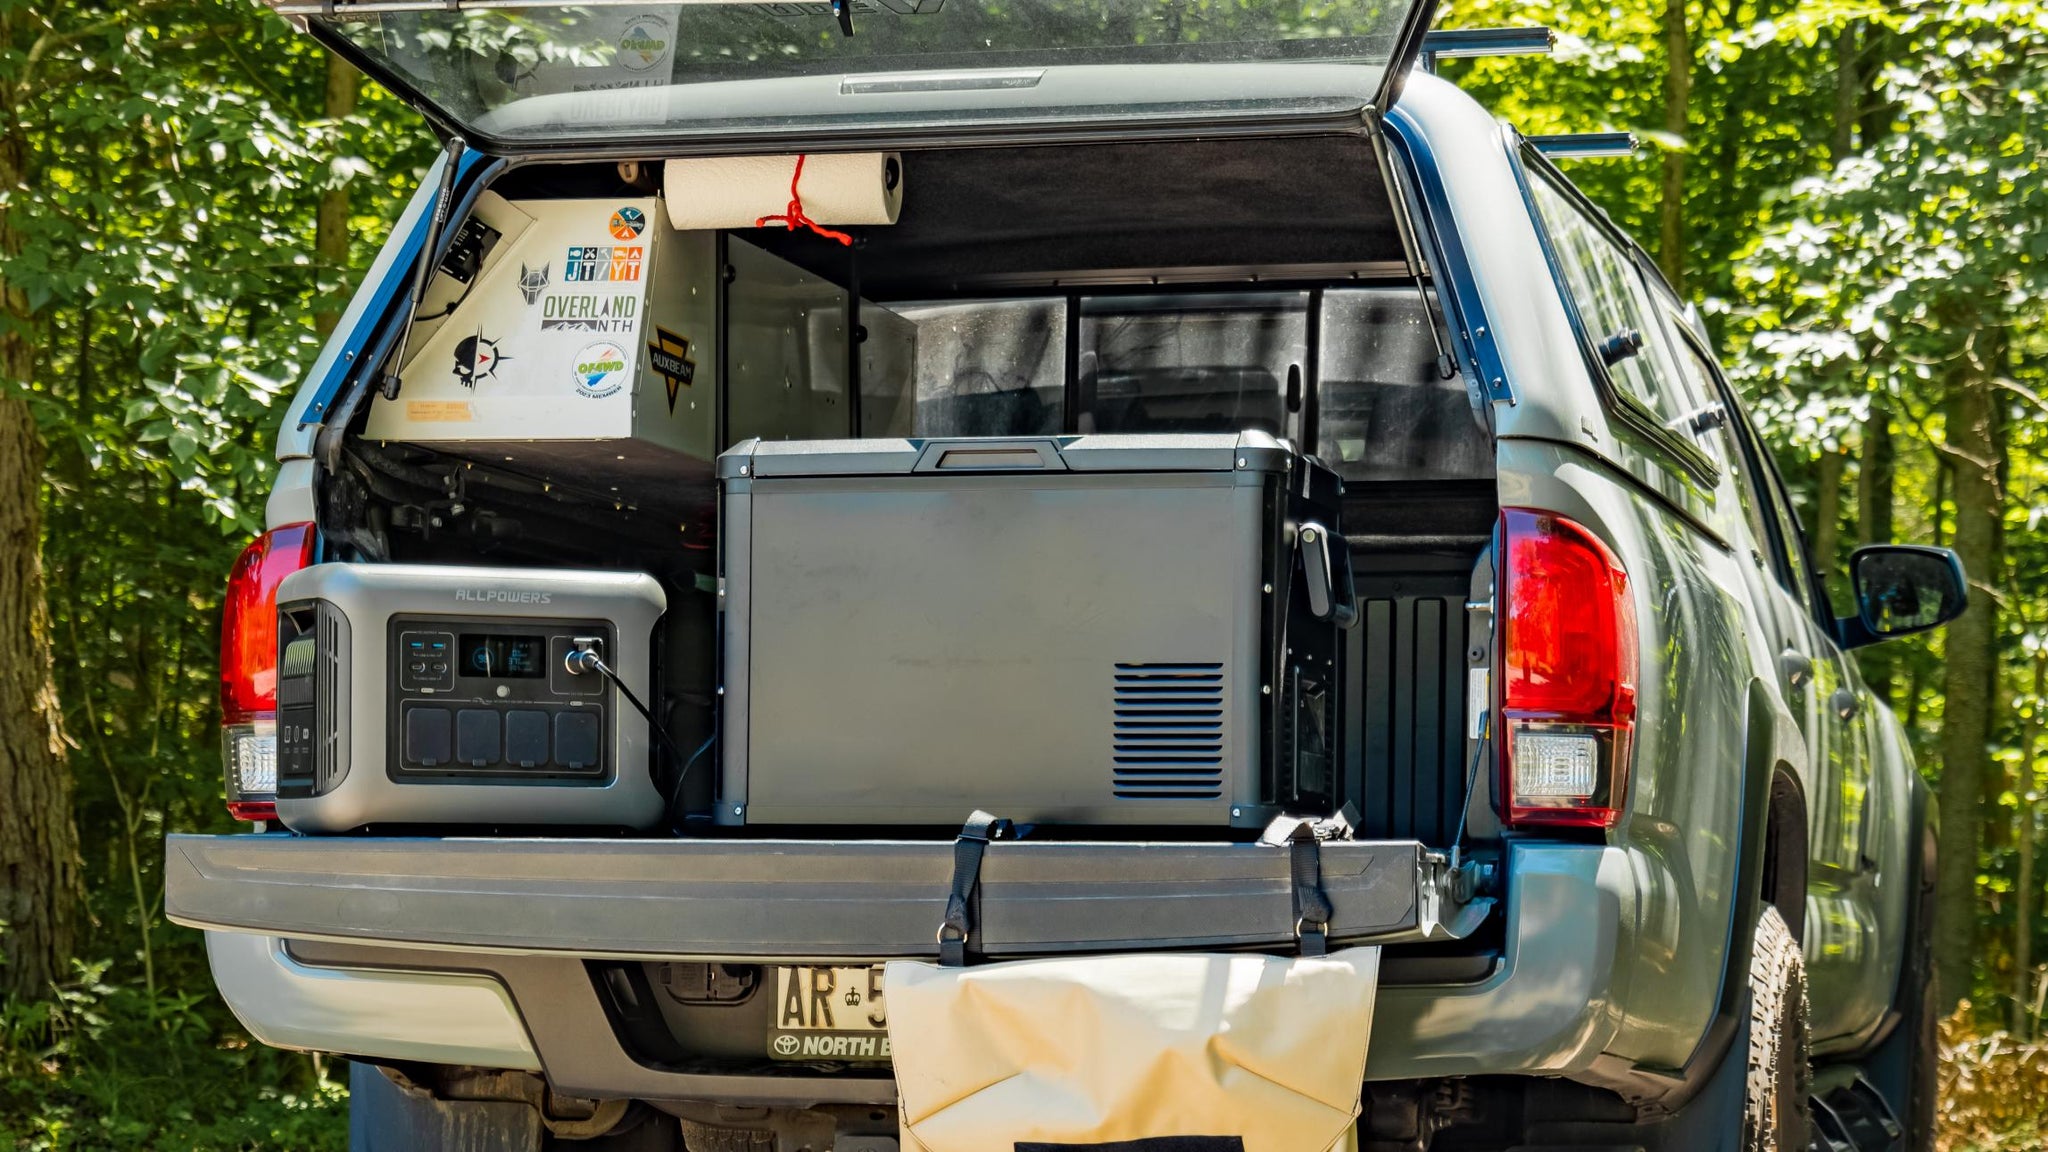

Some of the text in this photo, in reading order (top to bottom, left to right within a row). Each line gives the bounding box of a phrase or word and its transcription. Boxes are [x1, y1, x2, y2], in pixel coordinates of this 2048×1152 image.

[543, 295, 637, 318] OVERLAND
[577, 361, 624, 374] OF4WD
[652, 352, 692, 379] AUXBEAM
[455, 589, 552, 604] ALLPOWERS
[782, 968, 834, 1027] AR
[803, 1036, 876, 1056] NORTH
